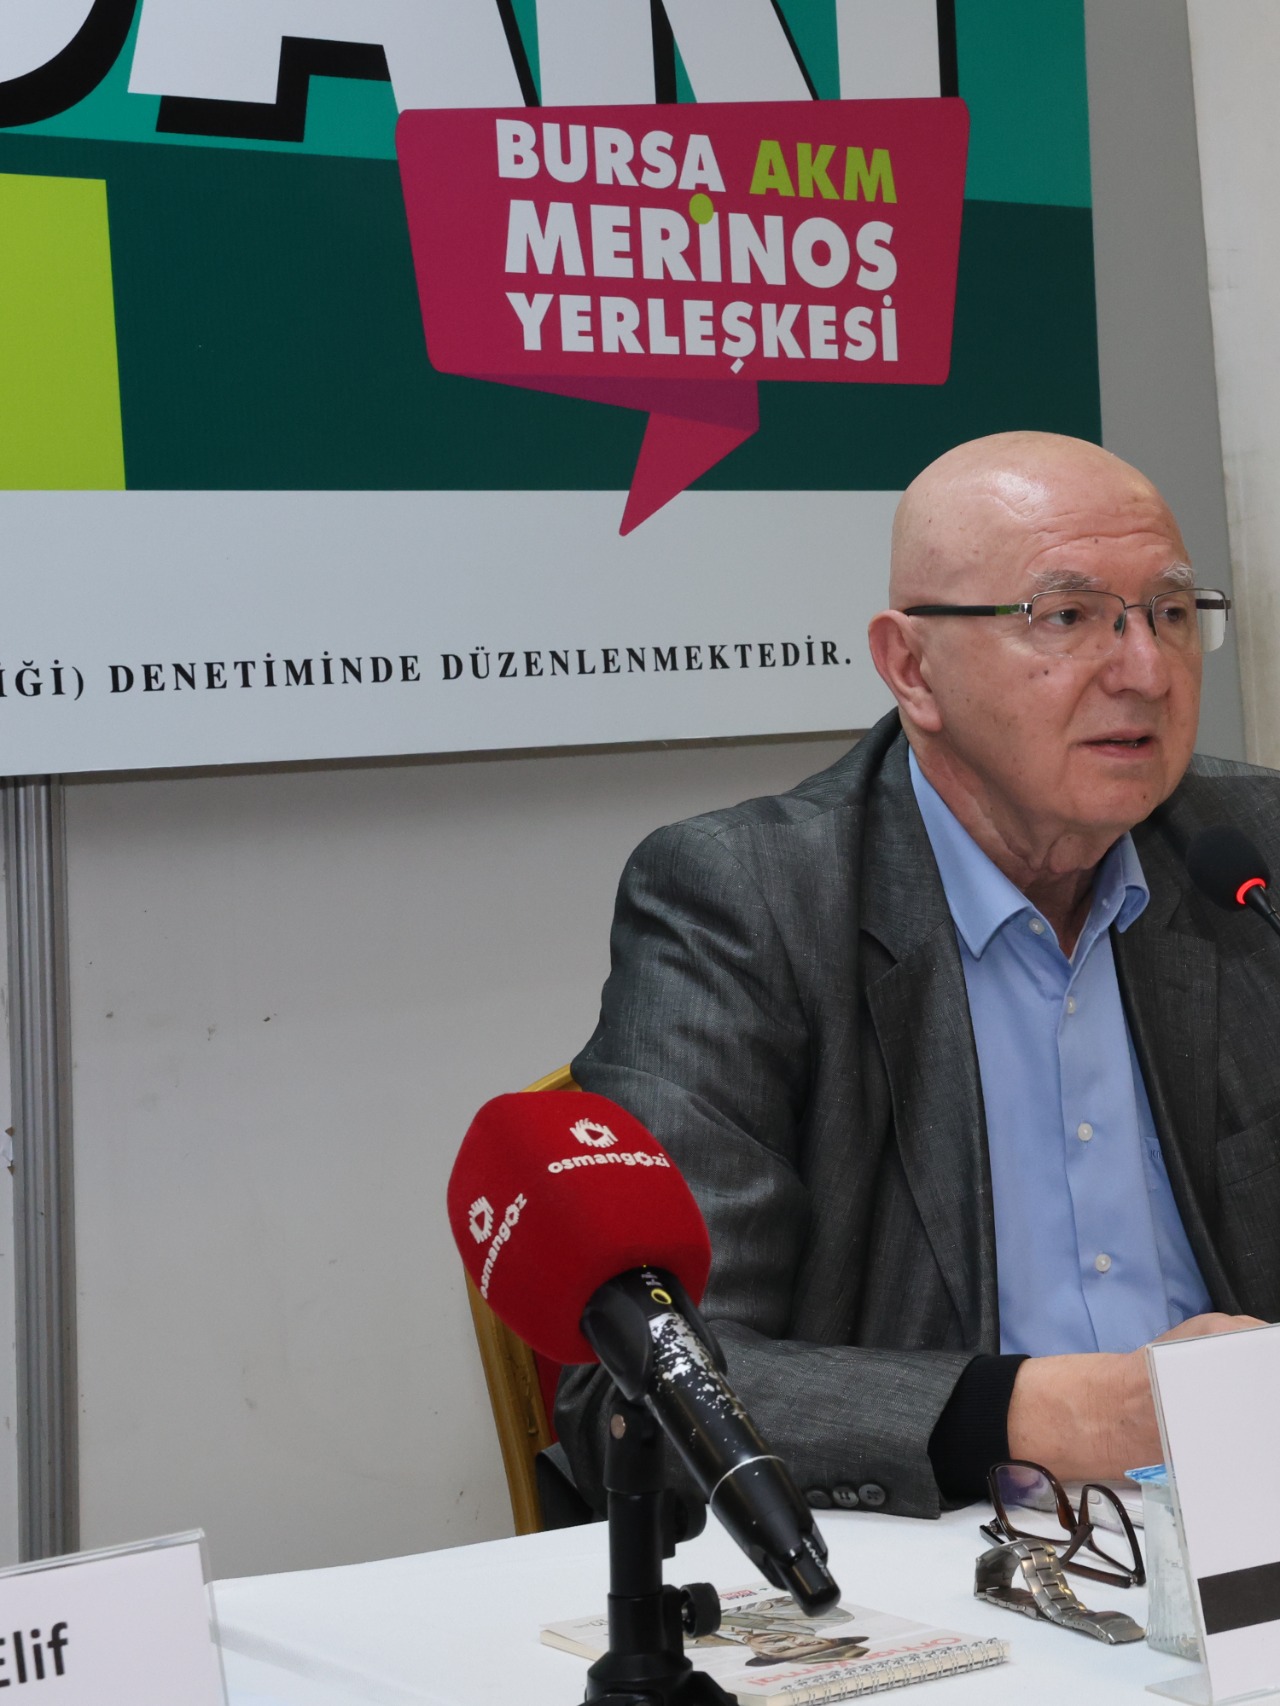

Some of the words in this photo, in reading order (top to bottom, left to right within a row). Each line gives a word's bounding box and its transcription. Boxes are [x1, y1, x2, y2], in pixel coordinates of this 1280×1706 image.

[496, 118, 726, 193] BURSA
[749, 140, 898, 204] AKM
[504, 193, 898, 291] MERİNOS
[504, 292, 898, 375] YERLEŞKESİ
[108, 651, 422, 694] DENETİMİNDE
[440, 634, 852, 681] DÜZENLENMEKTEDİR.
